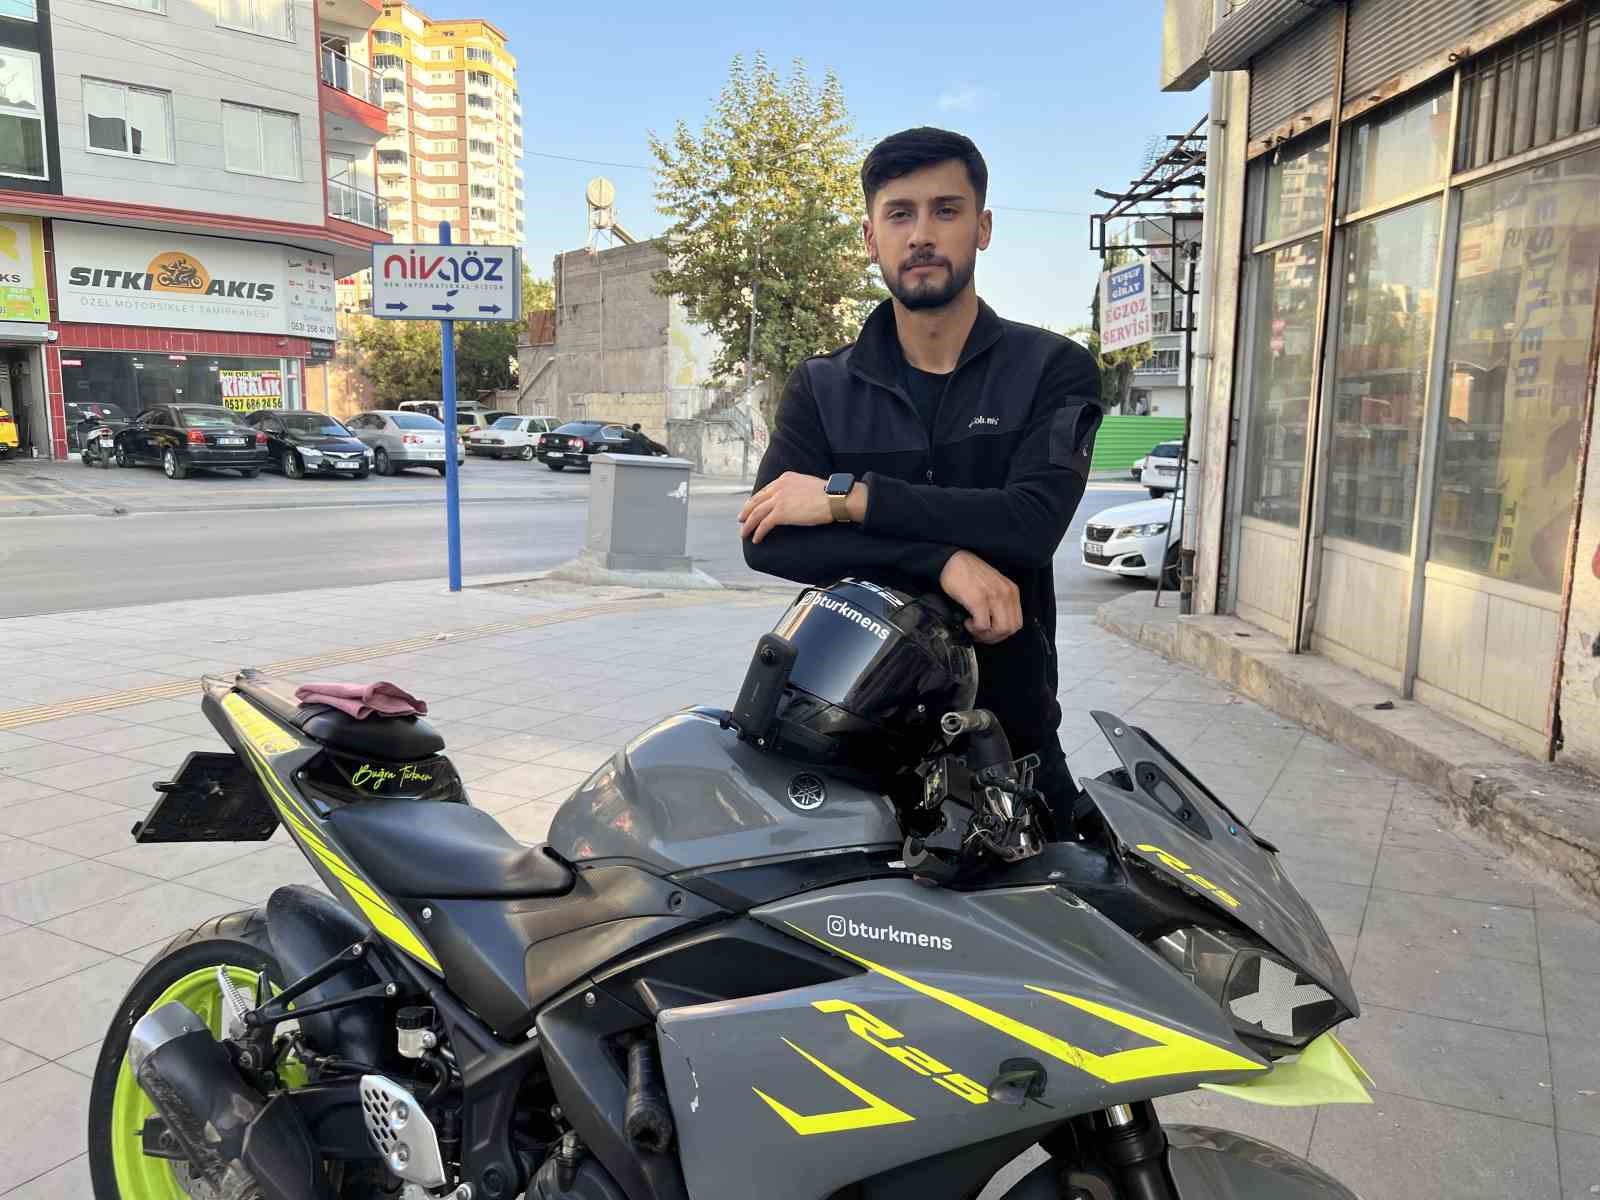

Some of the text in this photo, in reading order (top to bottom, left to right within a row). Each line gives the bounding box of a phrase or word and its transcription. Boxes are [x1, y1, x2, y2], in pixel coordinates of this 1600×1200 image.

[69, 267, 153, 290] SITKI
[1105, 298, 1147, 323] EGZOZ
[848, 919, 953, 950] bturkmens
[810, 998, 990, 1104] R25
